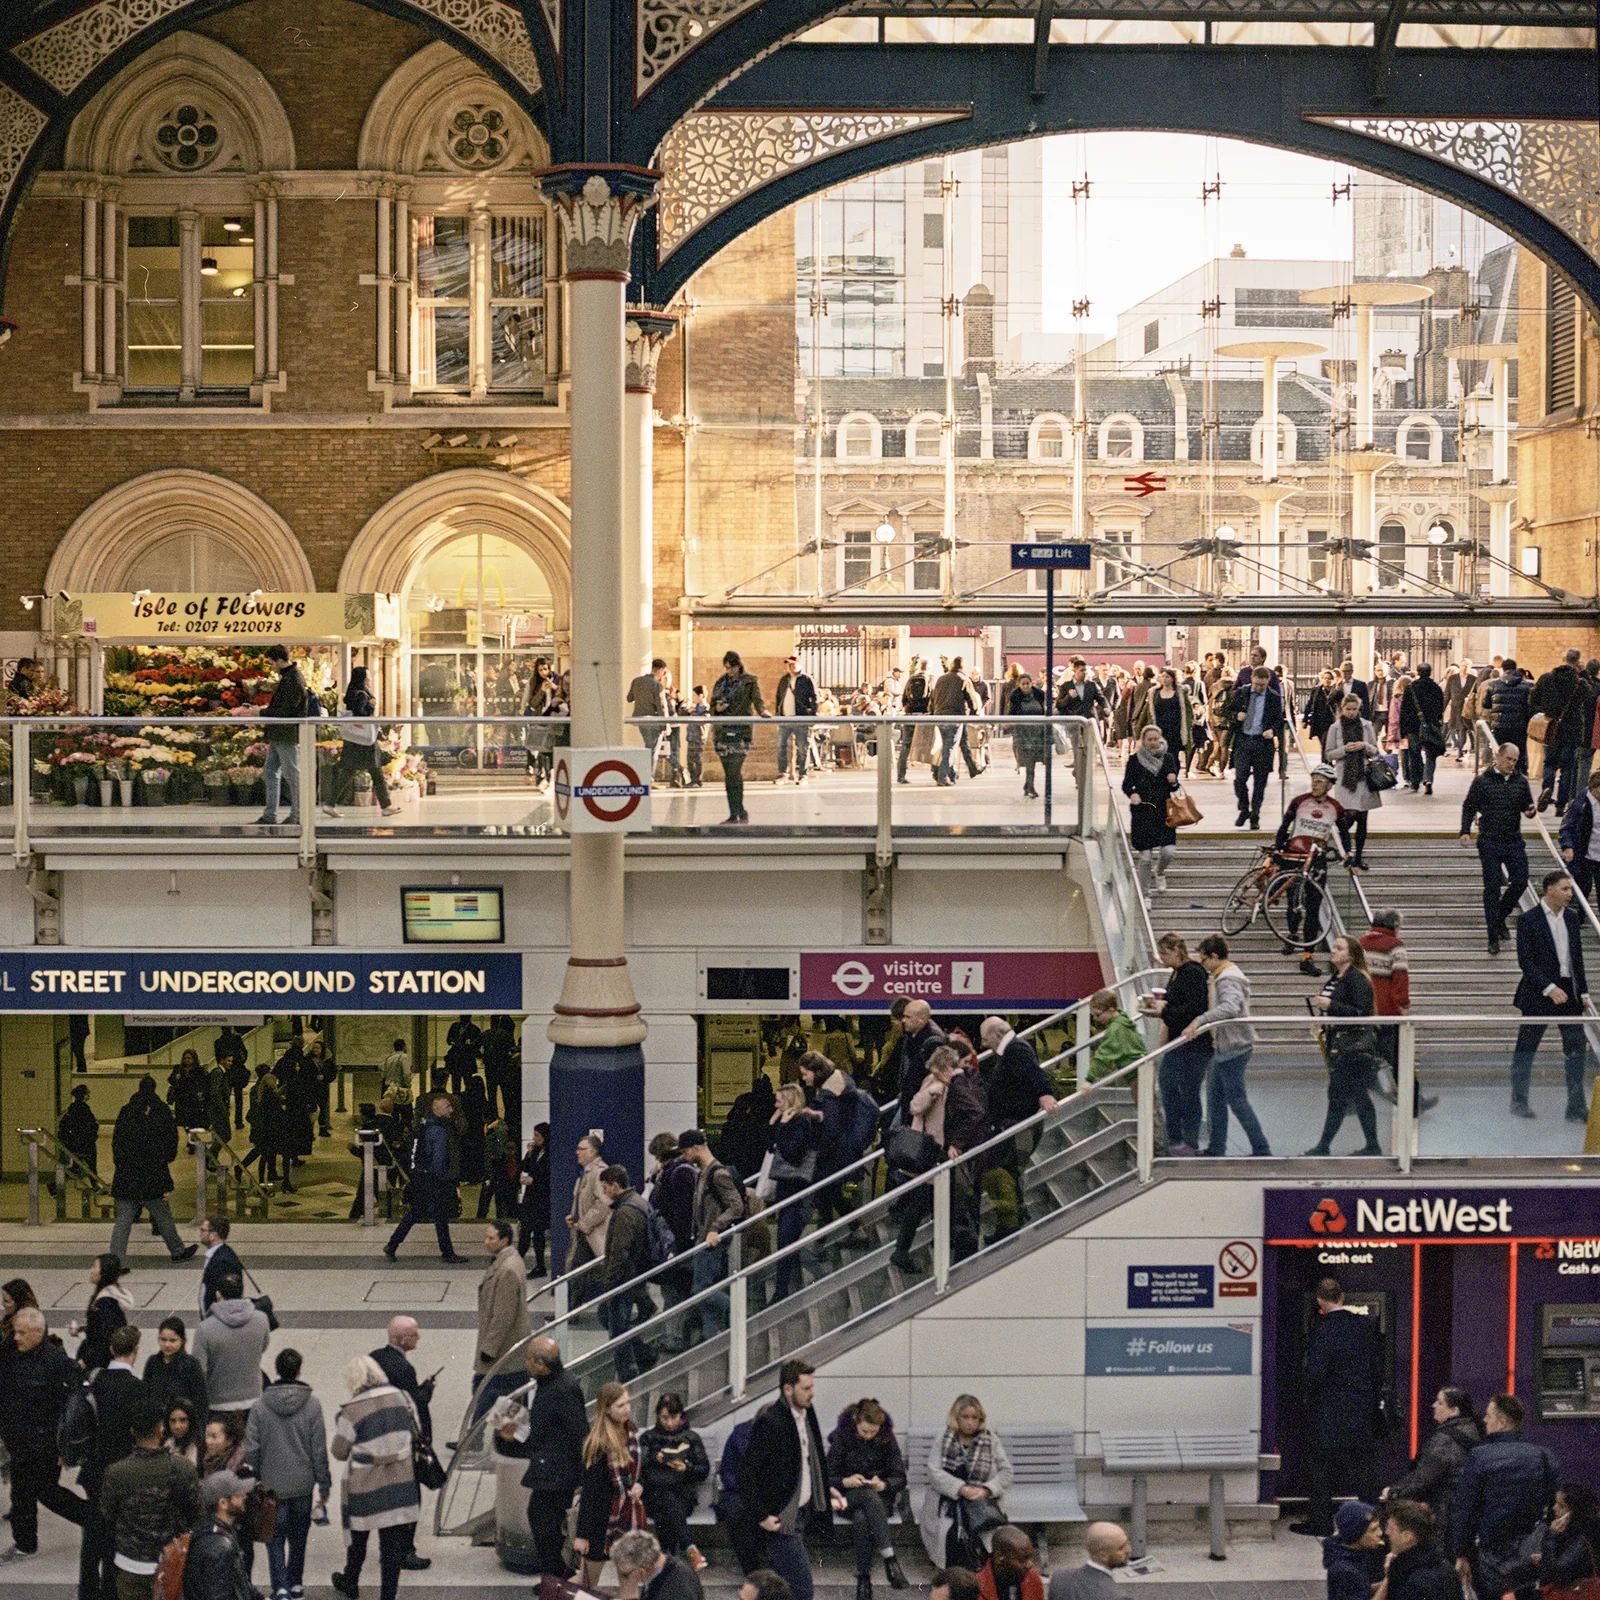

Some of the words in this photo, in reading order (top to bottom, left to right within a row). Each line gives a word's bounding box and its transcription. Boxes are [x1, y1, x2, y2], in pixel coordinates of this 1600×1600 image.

[1055, 548, 1073, 558] Lift
[134, 597, 177, 617] Isle
[185, 597, 208, 619] of
[216, 597, 306, 618] Flowers
[158, 621, 180, 632] Tel:
[185, 621, 219, 632] 0207
[224, 620, 282, 632] 4220078
[578, 786, 645, 796] UNDERGROUND
[883, 960, 942, 976] visitor
[0, 971, 16, 992] L
[30, 970, 127, 993] STREET
[139, 970, 356, 993] UNDERGROUND
[368, 970, 486, 993] STATION
[883, 979, 942, 994] centre
[1356, 1198, 1513, 1233] NatWest
[1318, 1252, 1350, 1264] Cash
[1350, 1252, 1373, 1264] out
[1558, 1262, 1590, 1274] Cash
[1196, 1343, 1214, 1354] us
